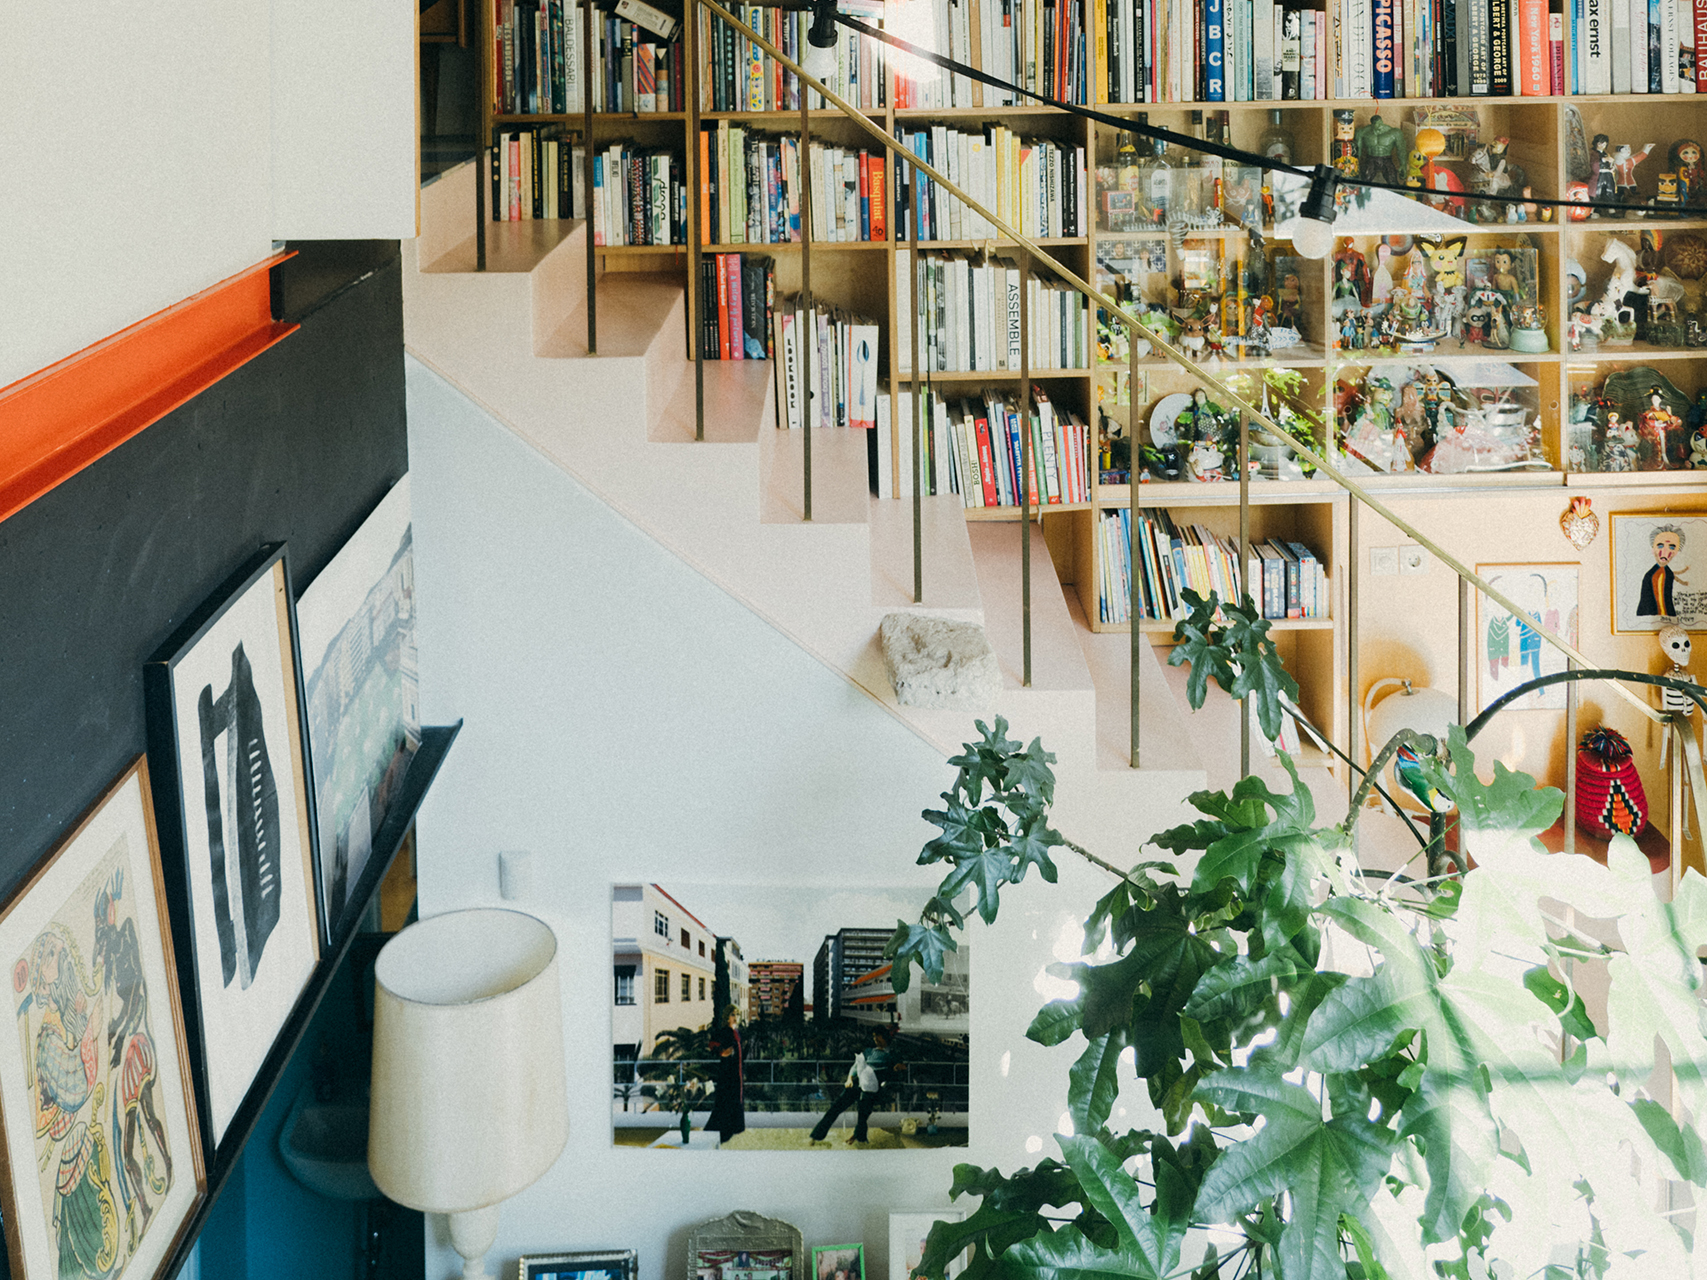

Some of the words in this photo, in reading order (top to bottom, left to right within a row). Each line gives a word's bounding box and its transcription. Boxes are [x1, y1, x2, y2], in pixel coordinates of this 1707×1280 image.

[503, 22, 512, 39] WES
[1530, 7, 1540, 28] New
[564, 18, 575, 85] BALDESSARI
[1471, 37, 1479, 72] GEORGE
[1530, 30, 1540, 53] York
[1589, 18, 1601, 59] ernst
[503, 40, 512, 81] ANDERSON
[1480, 61, 1487, 71] OF
[1492, 39, 1501, 76] GEORGE
[1501, 68, 1507, 76] OF
[1530, 55, 1540, 81] 1960
[1553, 46, 1562, 91] PIRANESI
[869, 171, 883, 221] Basquiat
[730, 281, 739, 306] History
[730, 308, 739, 316] of
[1008, 283, 1019, 356] ASSEMBLE
[730, 317, 739, 347] pictures
[787, 338, 796, 409] LOOKBOOK
[1043, 431, 1058, 479] PLENTY
